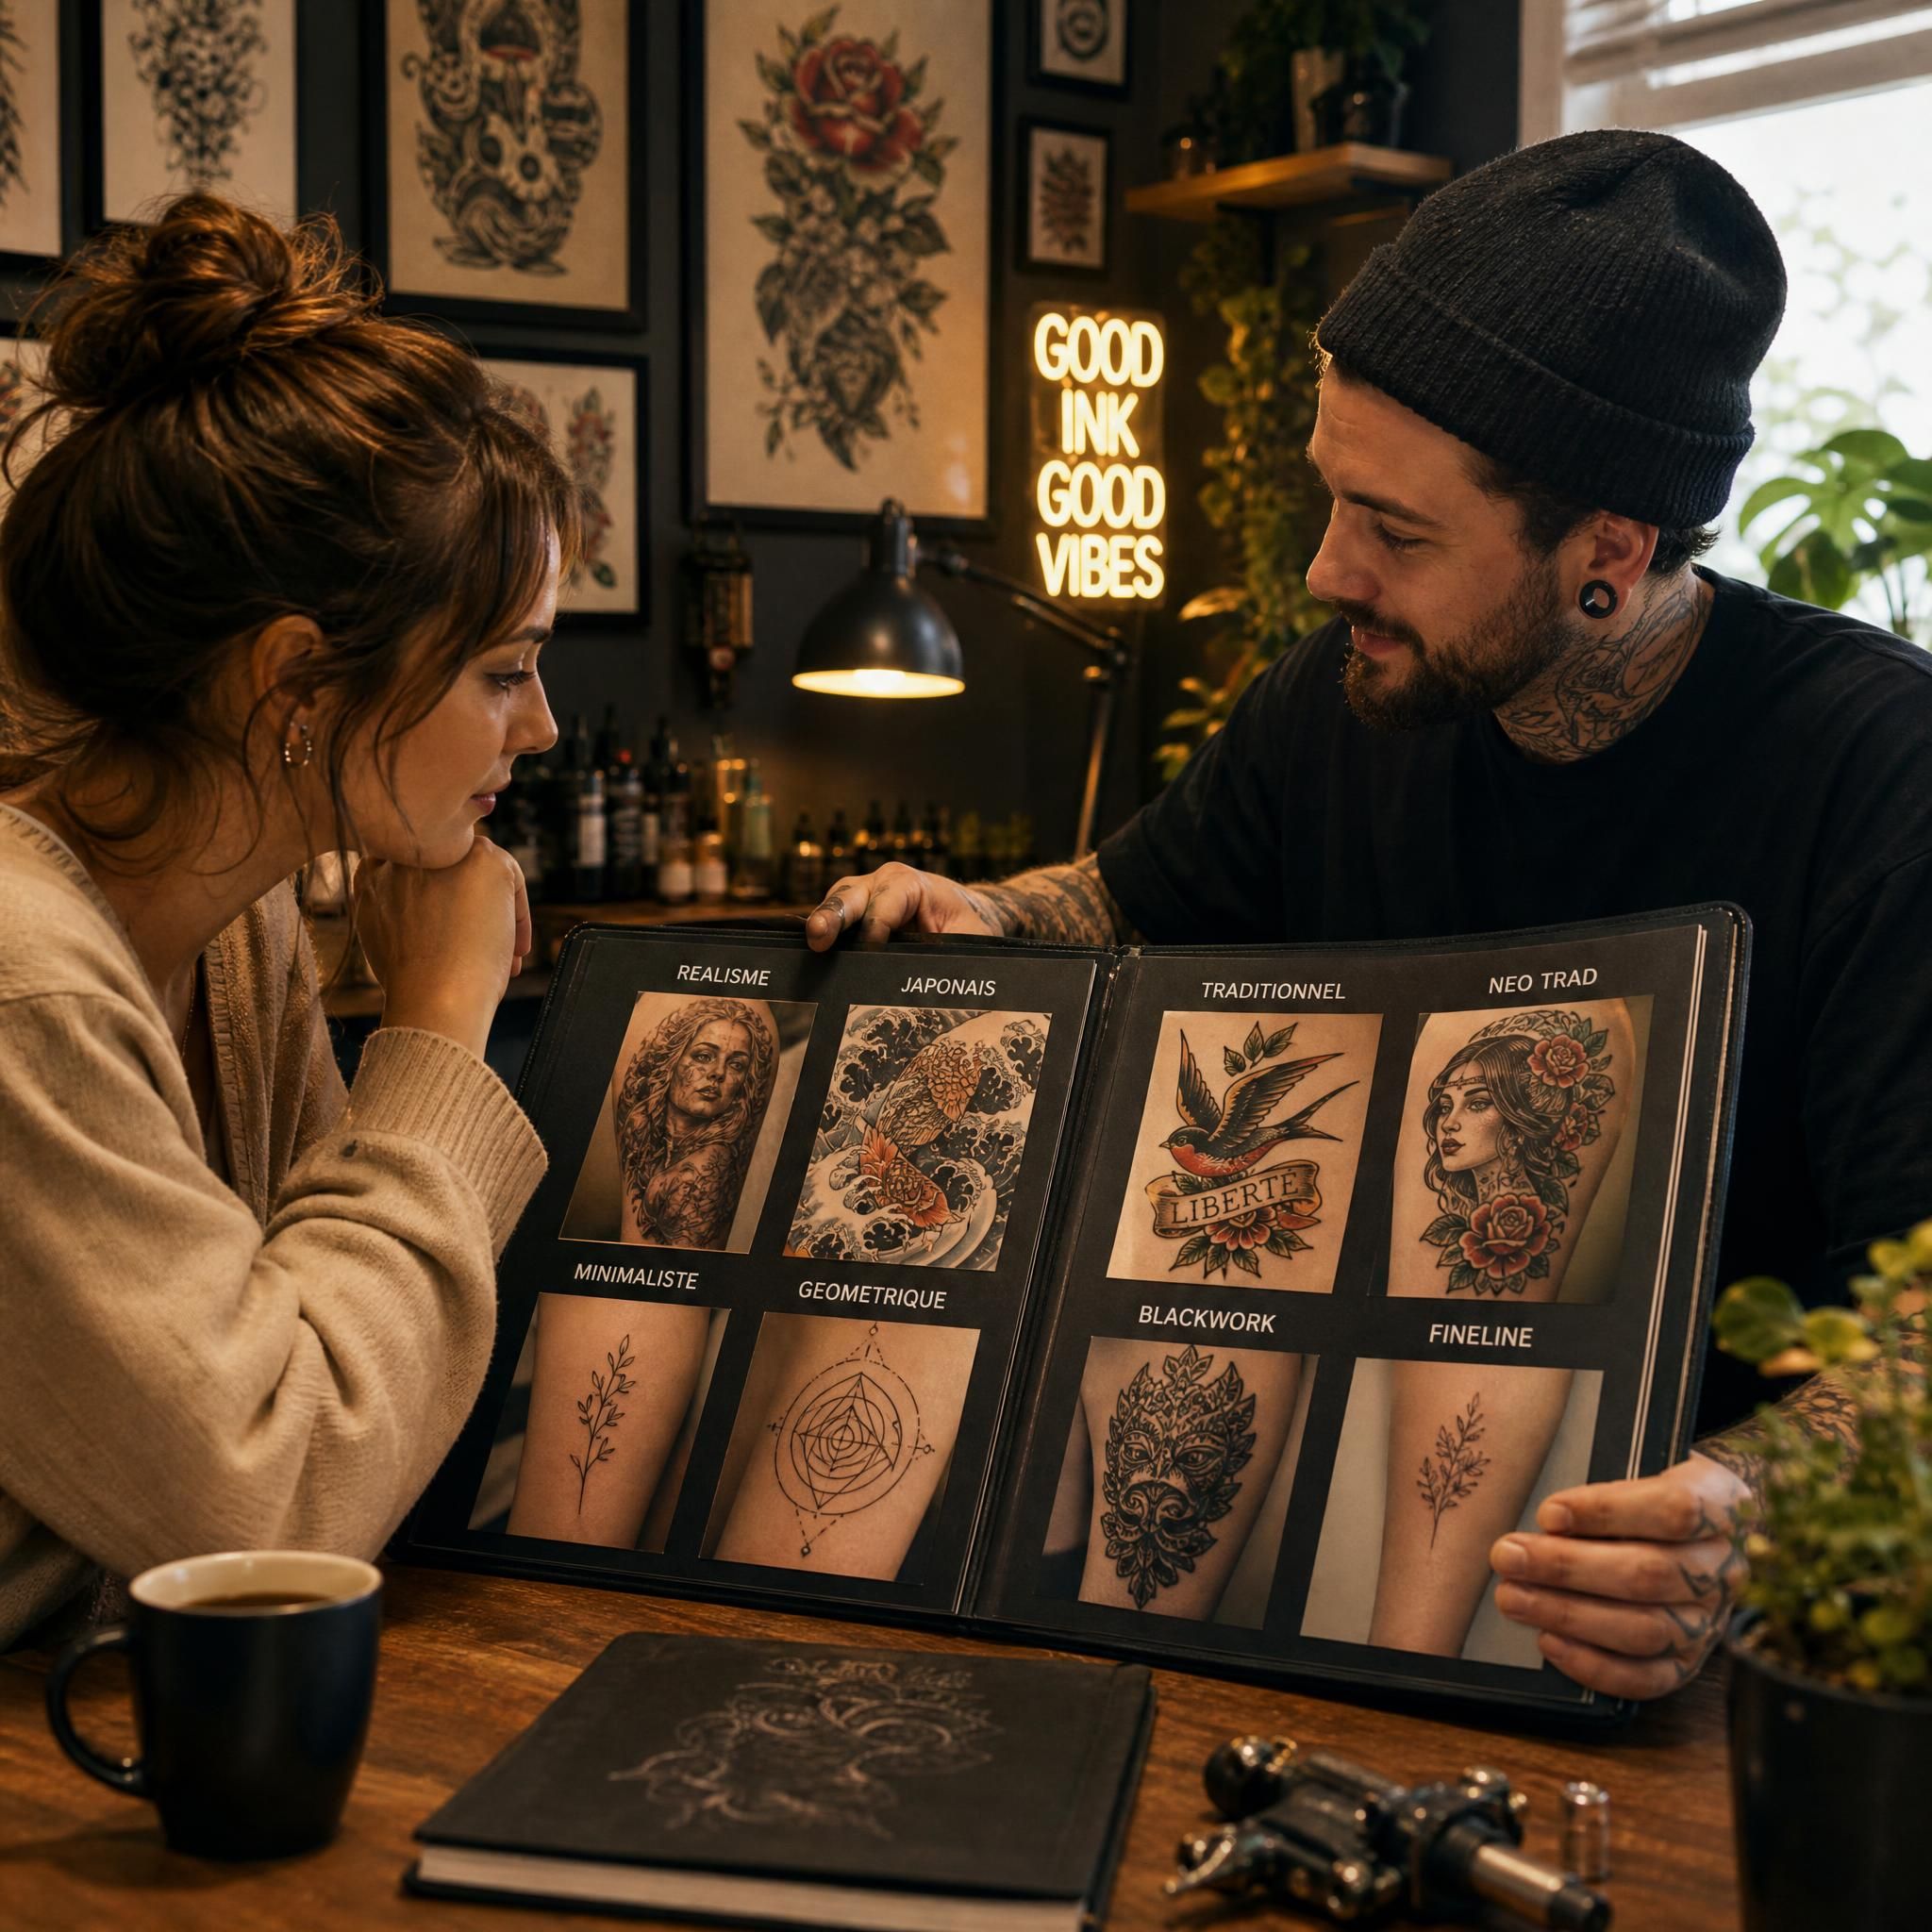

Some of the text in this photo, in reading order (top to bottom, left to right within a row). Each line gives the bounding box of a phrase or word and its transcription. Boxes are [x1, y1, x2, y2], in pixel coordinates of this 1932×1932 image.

[1034, 312, 1164, 388] GOOD
[1061, 388, 1140, 458] INK
[1037, 459, 1166, 530] GOOD
[1036, 532, 1165, 599] VIBES
[676, 964, 772, 987] REALISME
[901, 976, 997, 997] JAPONAIS
[1488, 968, 1598, 994] NEO TRAD
[1201, 982, 1346, 1000] TRADITIONNEL
[574, 1262, 699, 1291] MINIMALISTE
[798, 1280, 947, 1309] GEOMETRIQUE
[1138, 1305, 1276, 1334] BLACKWORK
[1428, 1324, 1534, 1349] FINELINE
